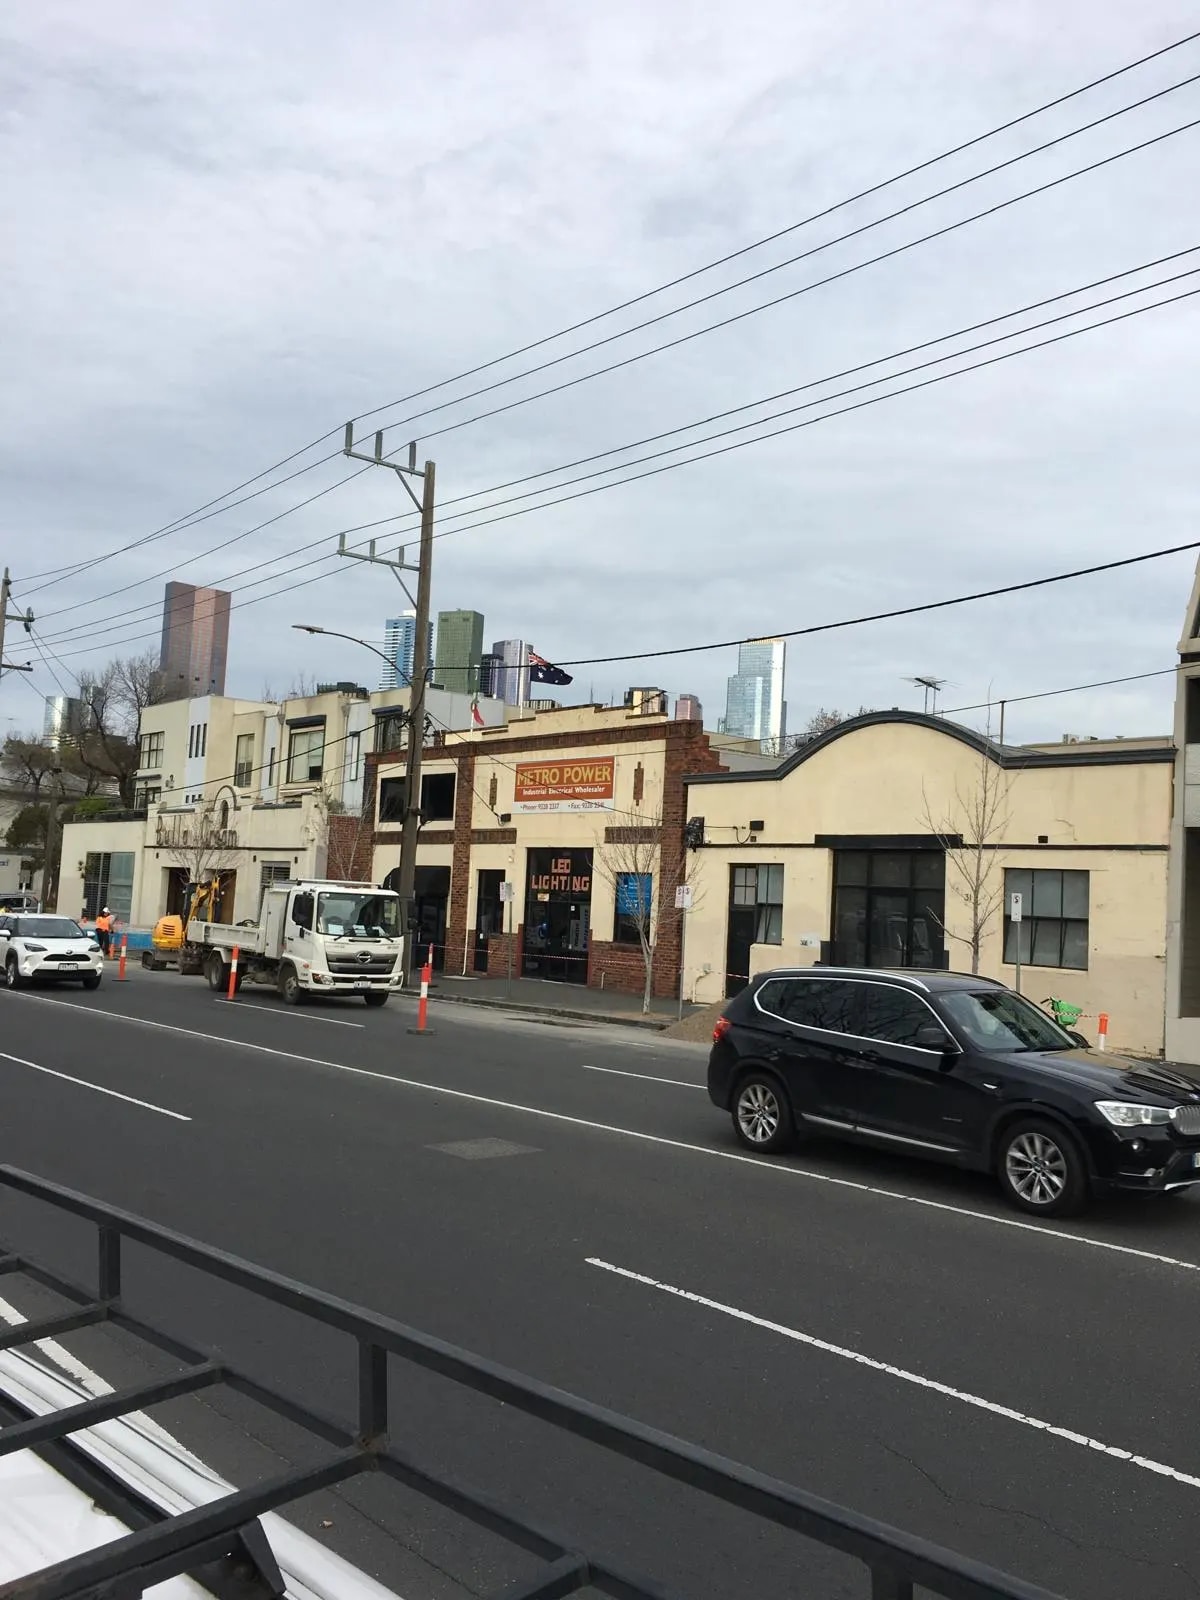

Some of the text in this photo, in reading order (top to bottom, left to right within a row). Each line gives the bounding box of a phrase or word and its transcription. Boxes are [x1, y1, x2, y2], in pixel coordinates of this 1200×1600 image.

[517, 766, 610, 785] METRO POWER
[523, 788, 547, 796] Industrial
[574, 785, 605, 794] Wholesaler
[552, 859, 570, 873] LED
[532, 875, 589, 890] LIGHTING
